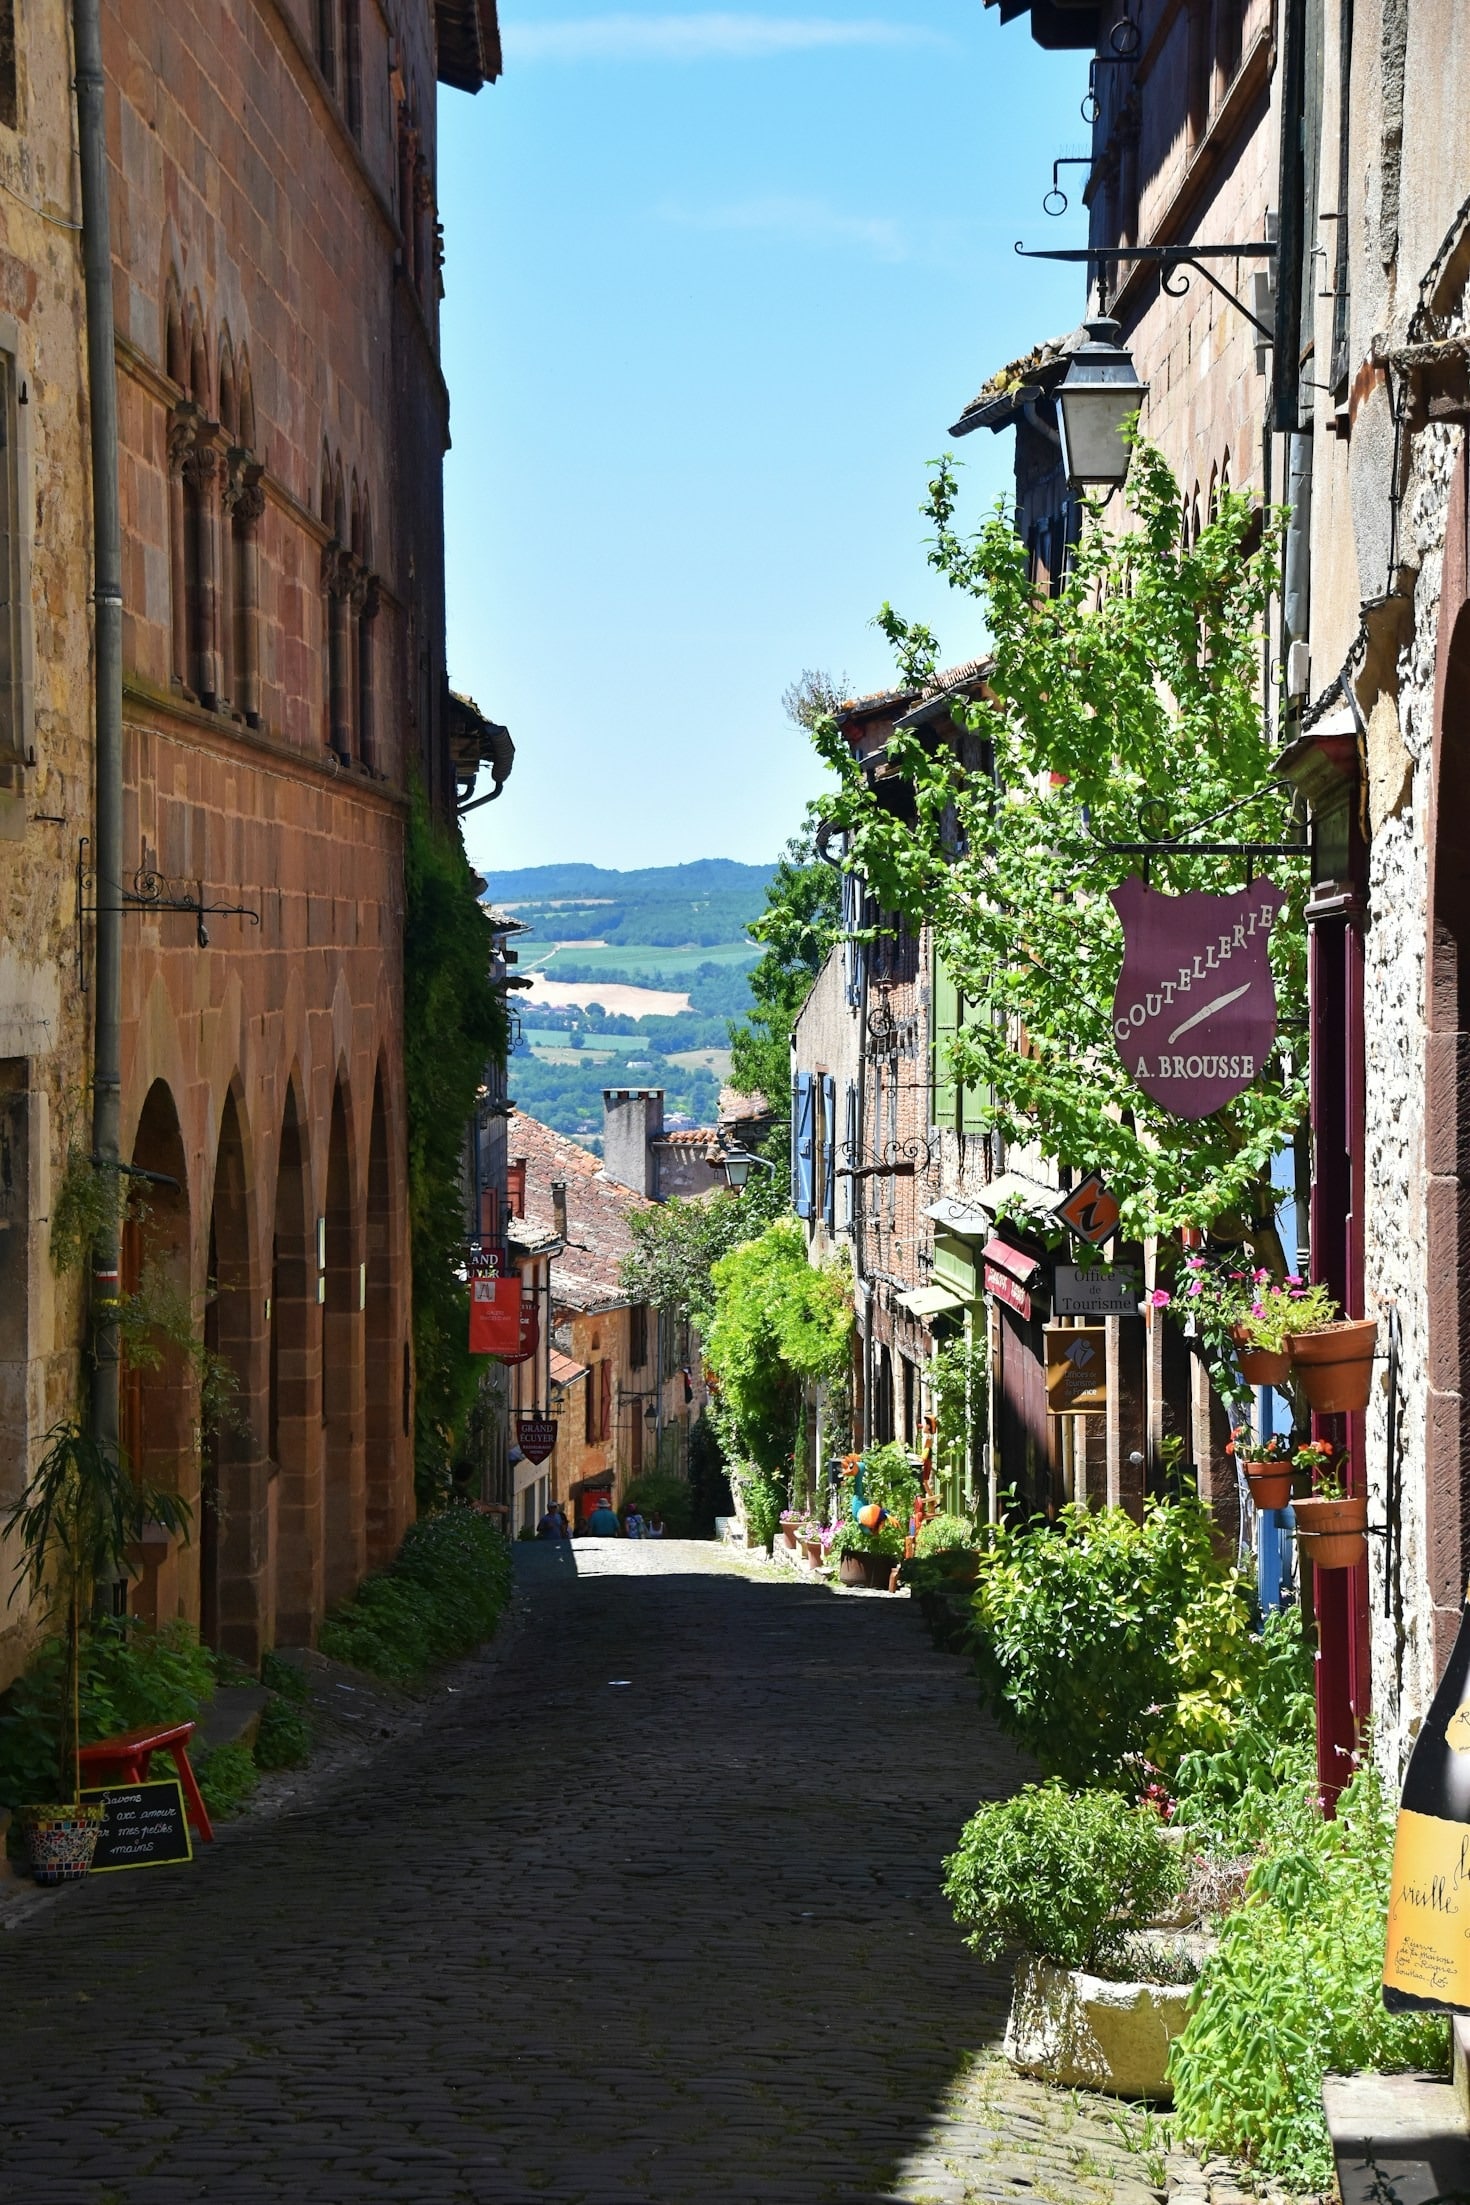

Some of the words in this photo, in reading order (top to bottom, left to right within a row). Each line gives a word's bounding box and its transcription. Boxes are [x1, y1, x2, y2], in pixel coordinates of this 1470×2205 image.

[1114, 904, 1273, 1040] COUTELLERIE
[1134, 1056, 1155, 1078] A.
[1158, 1056, 1255, 1079] BROUSSE
[471, 1254, 499, 1265] AND
[1074, 1269, 1116, 1282] Office
[1089, 1285, 1102, 1295] de
[1062, 1297, 1131, 1311] Tourisme
[521, 1424, 553, 1433] GRAND
[100, 1792, 142, 1805] Savons
[139, 1808, 177, 1820] amour
[98, 1829, 110, 1838] ar
[118, 1827, 140, 1837] mes
[110, 1839, 155, 1855] mains
